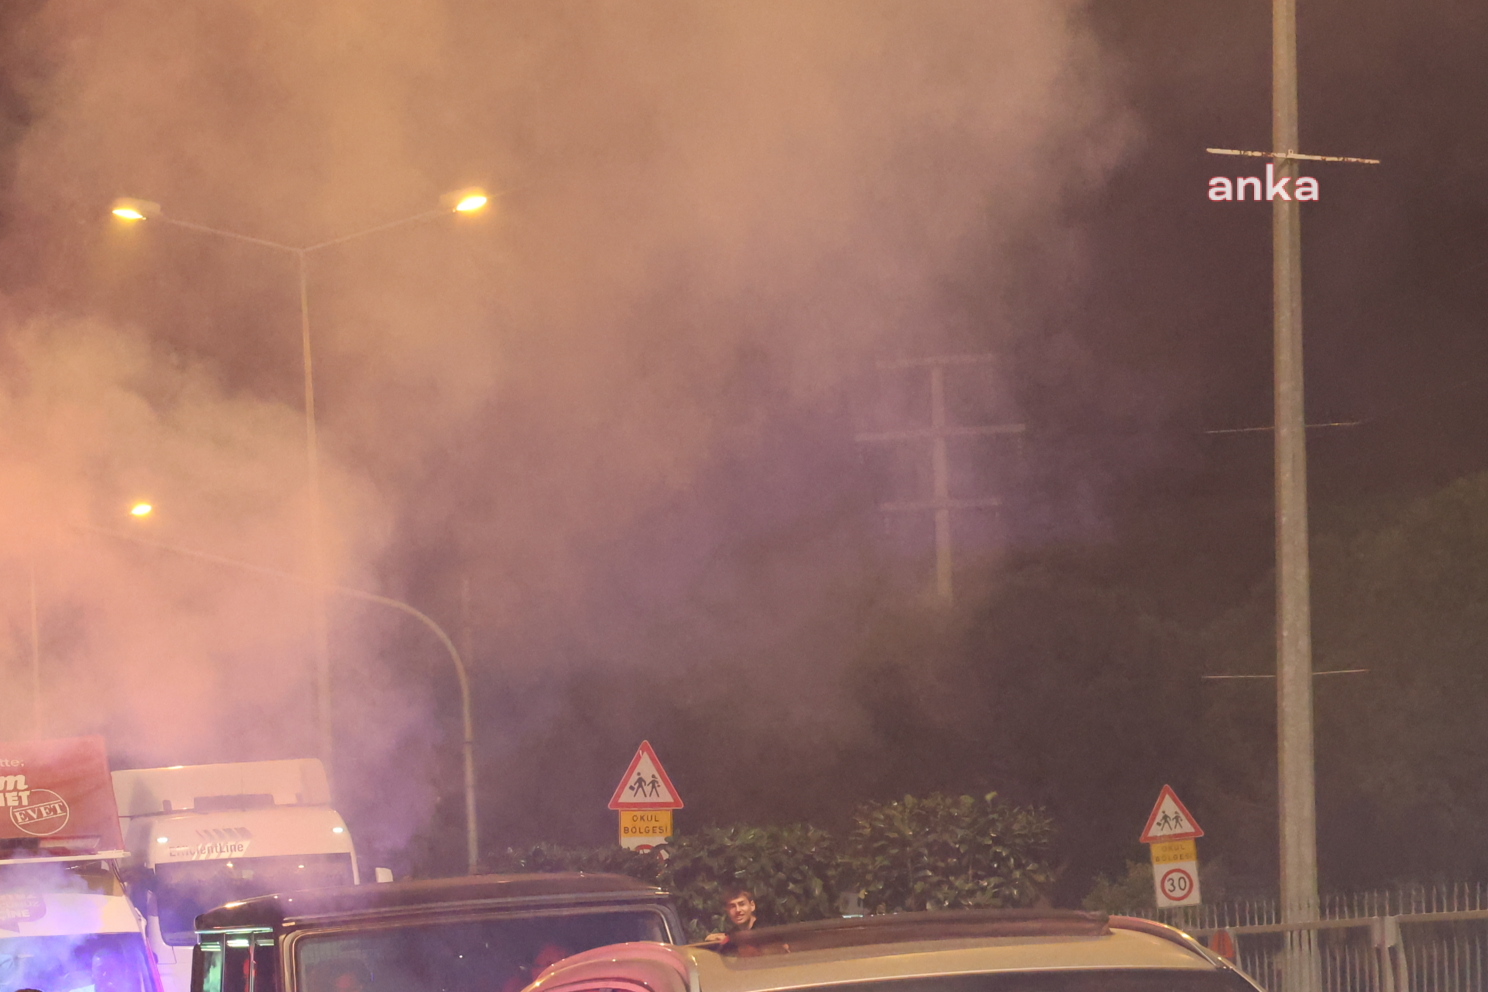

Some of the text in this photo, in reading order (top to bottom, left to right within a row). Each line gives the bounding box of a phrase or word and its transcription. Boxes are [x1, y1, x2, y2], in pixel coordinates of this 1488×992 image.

[14, 803, 63, 823] EVET
[632, 814, 659, 822] OKUL
[1167, 876, 1187, 893] 30
